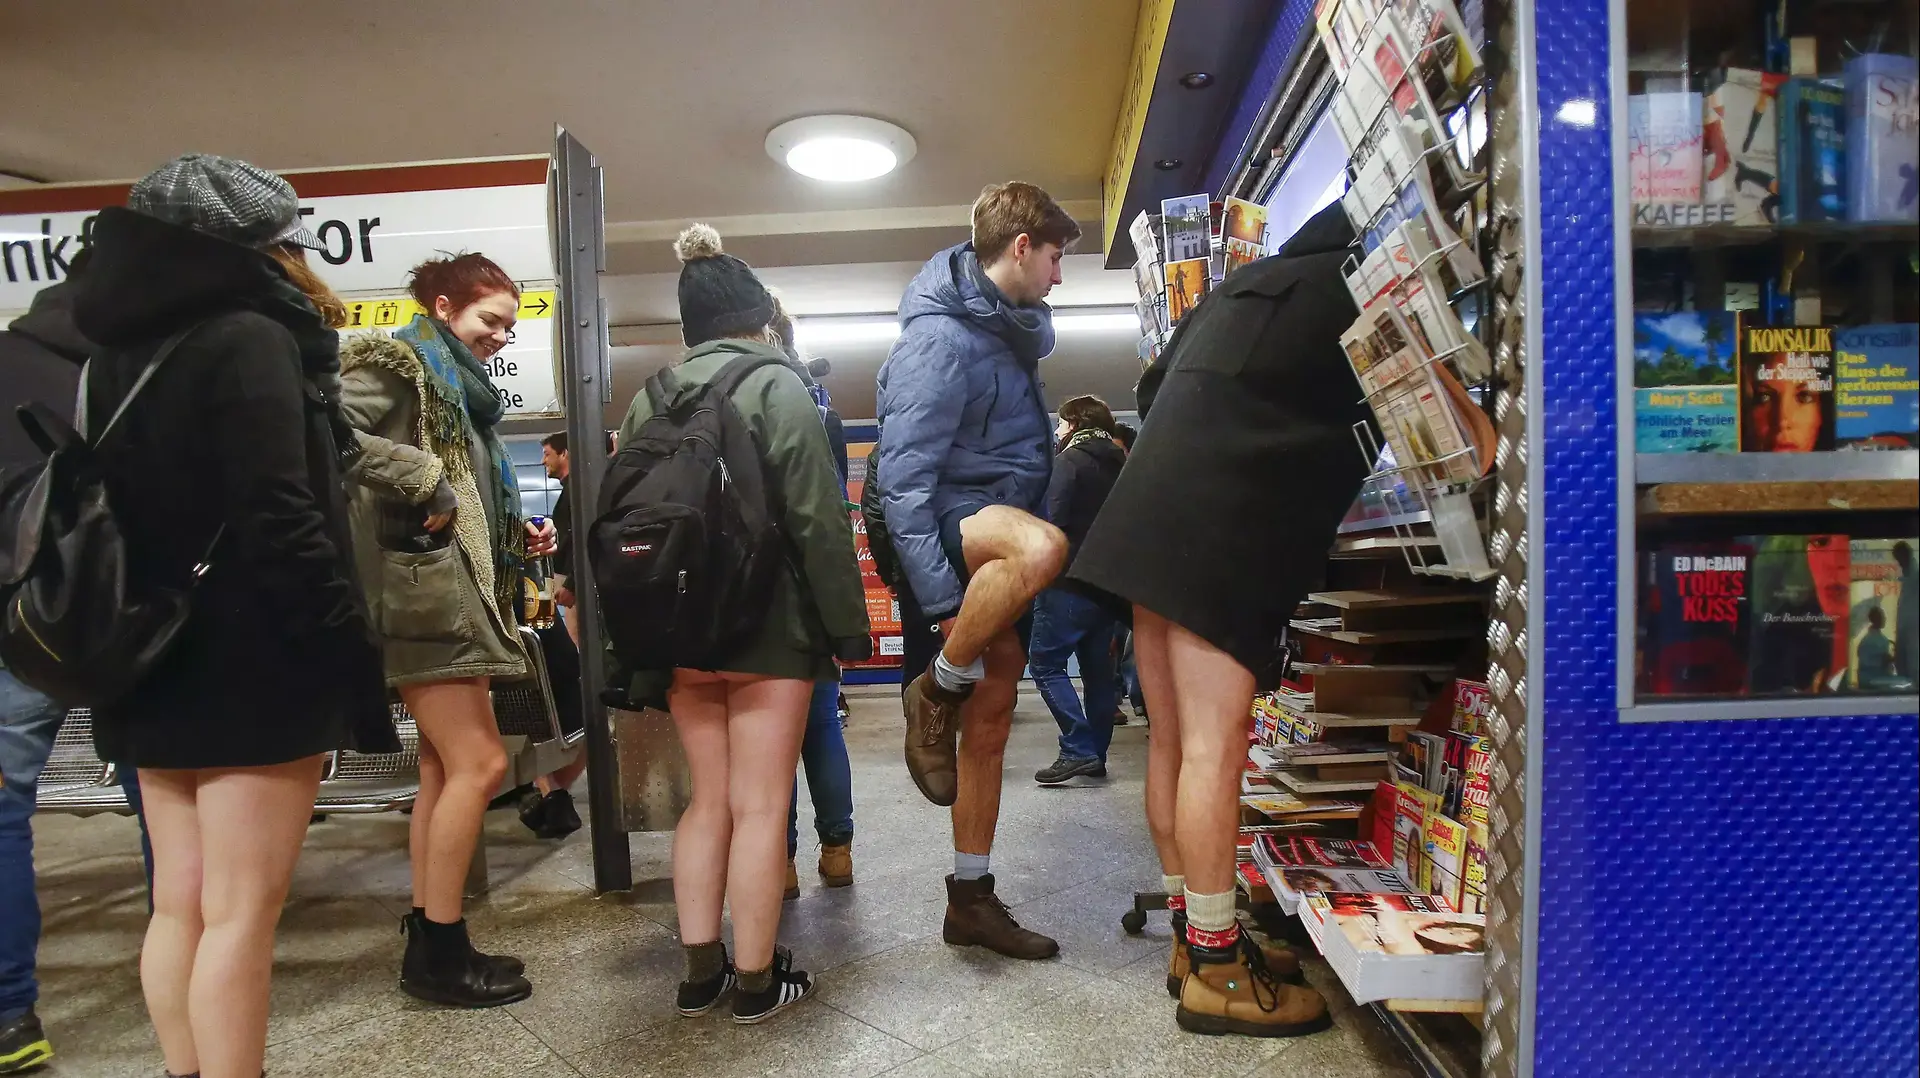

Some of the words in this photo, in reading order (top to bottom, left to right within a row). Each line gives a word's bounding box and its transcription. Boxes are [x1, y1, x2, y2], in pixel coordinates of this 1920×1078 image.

[1634, 203, 1736, 226] KAFFEE
[1750, 328, 1832, 353] KONSALIK
[1811, 353, 1830, 368] wie
[1837, 351, 1868, 364] Das
[1758, 364, 1776, 380] der
[1837, 366, 1877, 378] Haus
[1879, 364, 1908, 378] der
[1649, 392, 1685, 409] Mary
[1687, 391, 1725, 405] Scott
[1637, 414, 1694, 427] Fröhliche
[1697, 414, 1736, 426] Ferien
[1660, 430, 1678, 439] am
[1682, 427, 1713, 438] Meer
[621, 544, 652, 553] EASTPAK
[1673, 556, 1691, 571] ED
[1693, 556, 1747, 572] McBAIN
[1675, 570, 1745, 597] TODES
[1683, 596, 1739, 625] KUSS
[1763, 612, 1782, 623] Der
